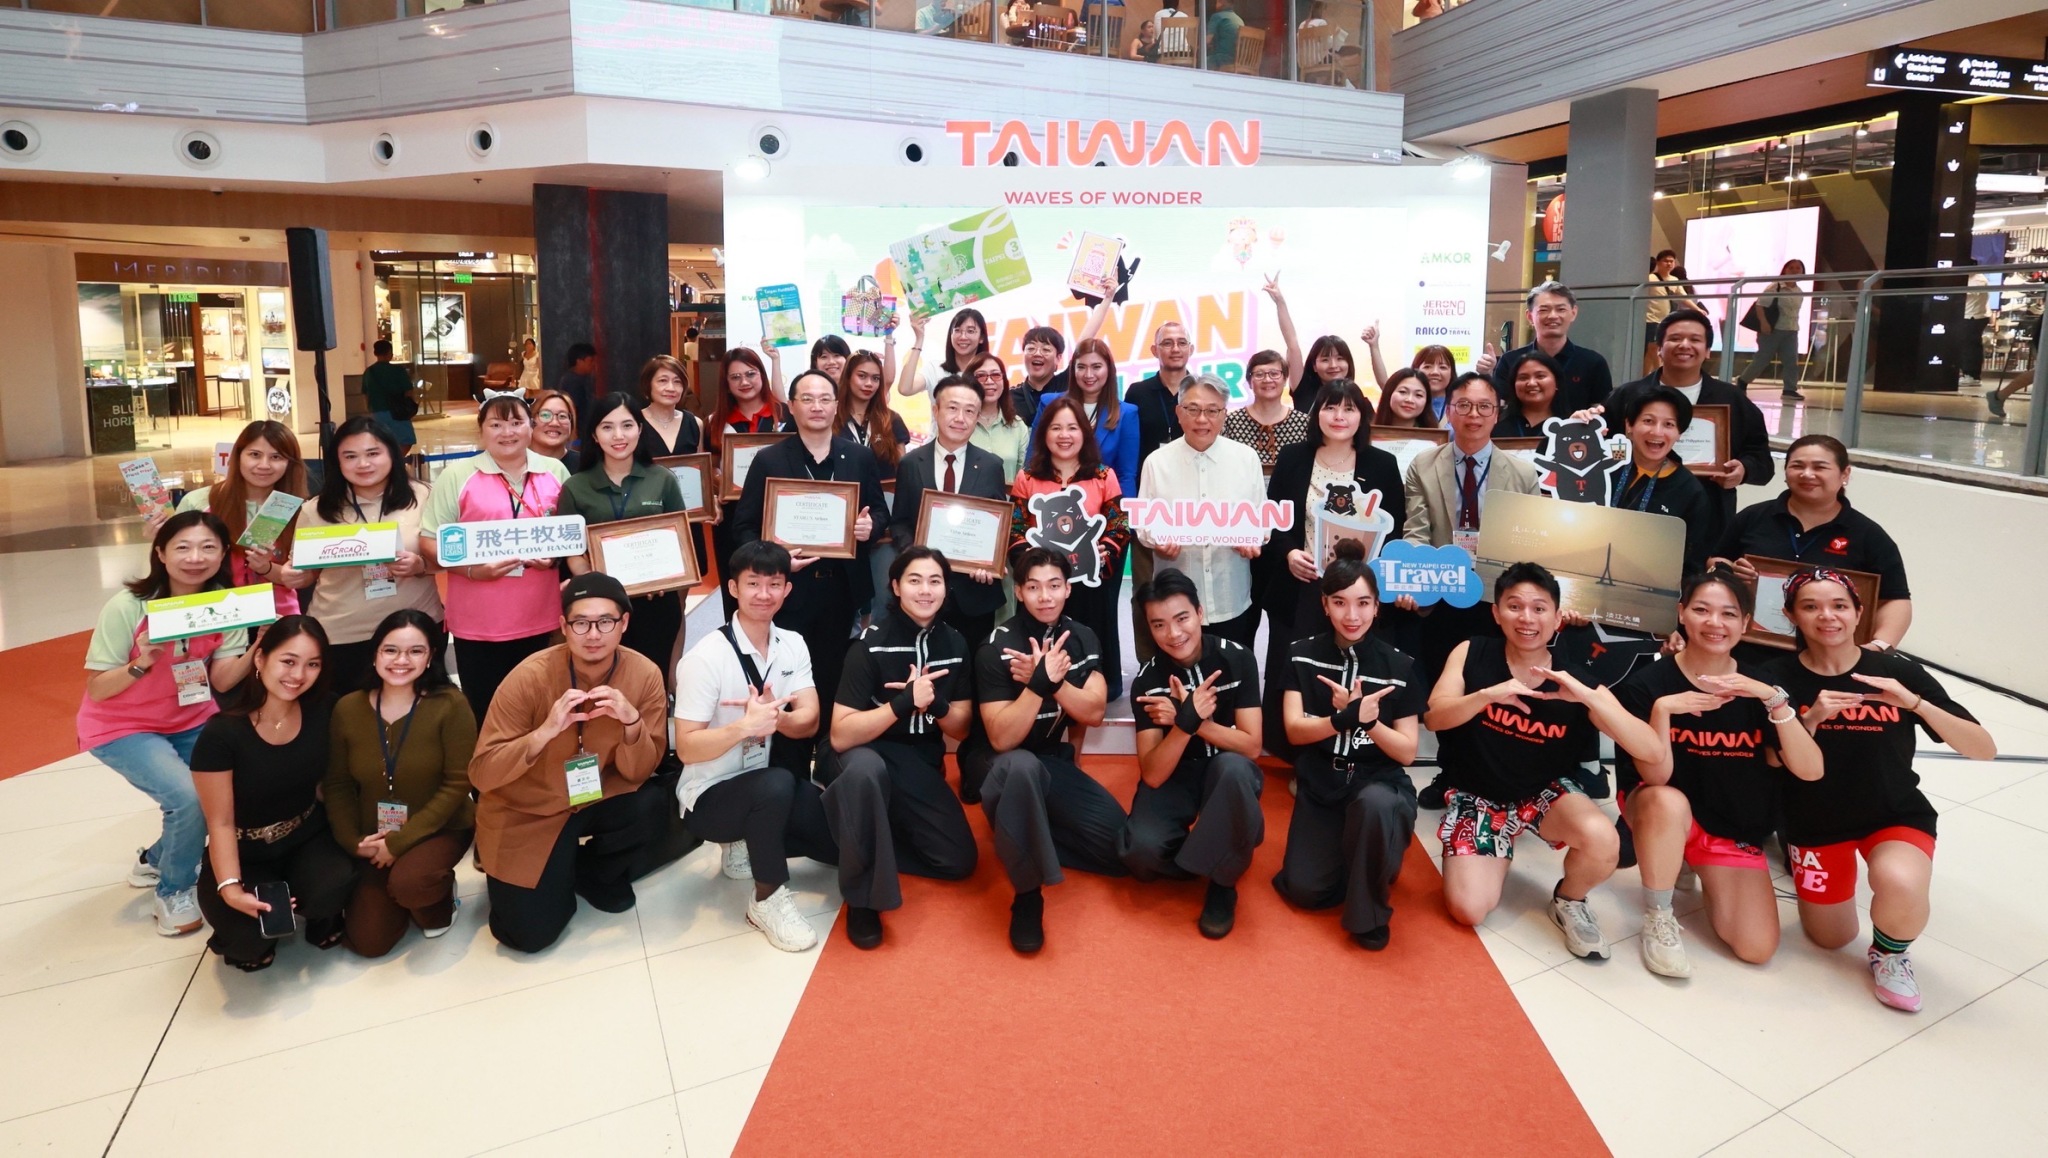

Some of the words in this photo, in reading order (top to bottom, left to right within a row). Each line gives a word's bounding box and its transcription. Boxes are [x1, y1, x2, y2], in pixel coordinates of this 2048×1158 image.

[945, 120, 1261, 167] TAIWAN
[1004, 191, 1073, 204] WAVES
[1080, 191, 1106, 204] OF
[1112, 191, 1202, 205] WONDER
[1416, 327, 1447, 336] RAKSO
[1123, 501, 1293, 529] TAIWAN
[475, 523, 583, 549] 飛牛牧場
[1157, 535, 1193, 544] WAVES
[1195, 535, 1208, 544] OF
[1212, 535, 1259, 544] WONDER
[475, 549, 514, 558] FLYING
[518, 546, 544, 555] COW
[549, 542, 583, 552] RANCH
[1379, 560, 1466, 585] Travel
